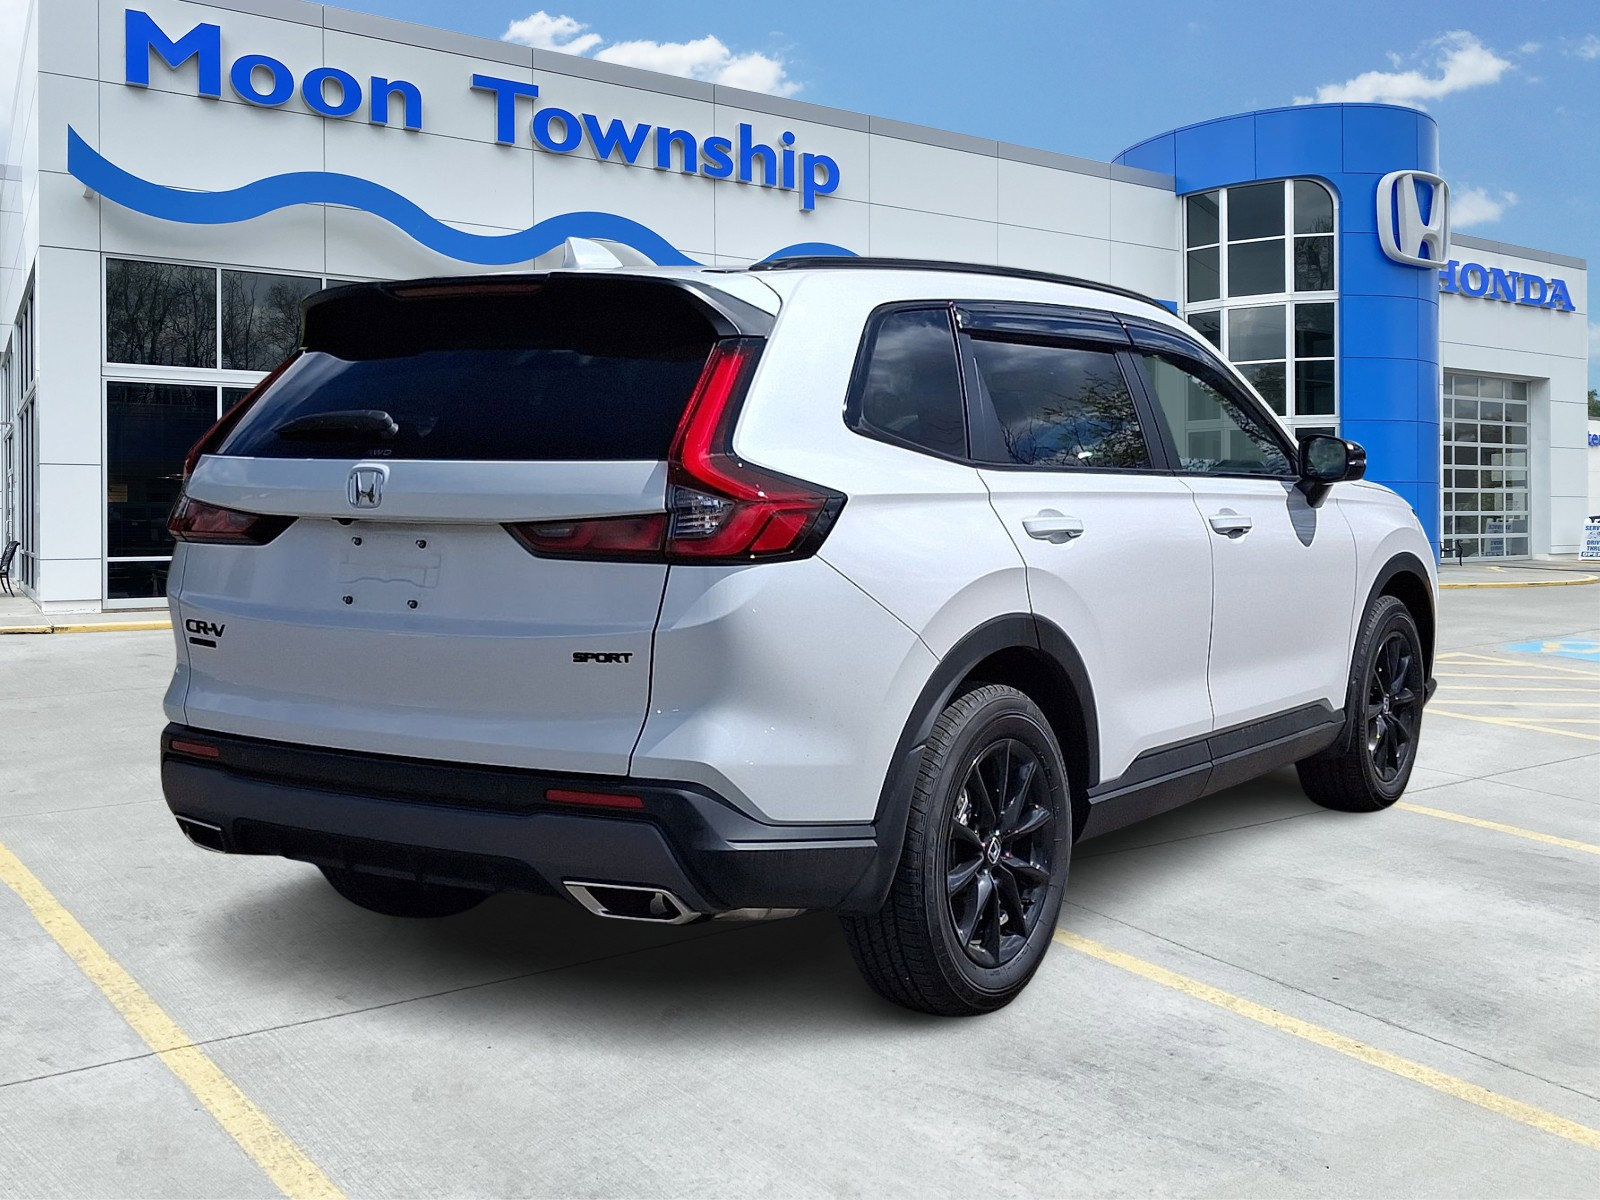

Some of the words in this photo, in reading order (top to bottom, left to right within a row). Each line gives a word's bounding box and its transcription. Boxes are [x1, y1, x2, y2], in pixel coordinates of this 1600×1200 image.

[125, 8, 422, 131] Moon
[470, 73, 841, 212] Township
[1439, 259, 1576, 312] HONDA
[185, 618, 226, 638] CR-V
[572, 652, 633, 664] SPORT
